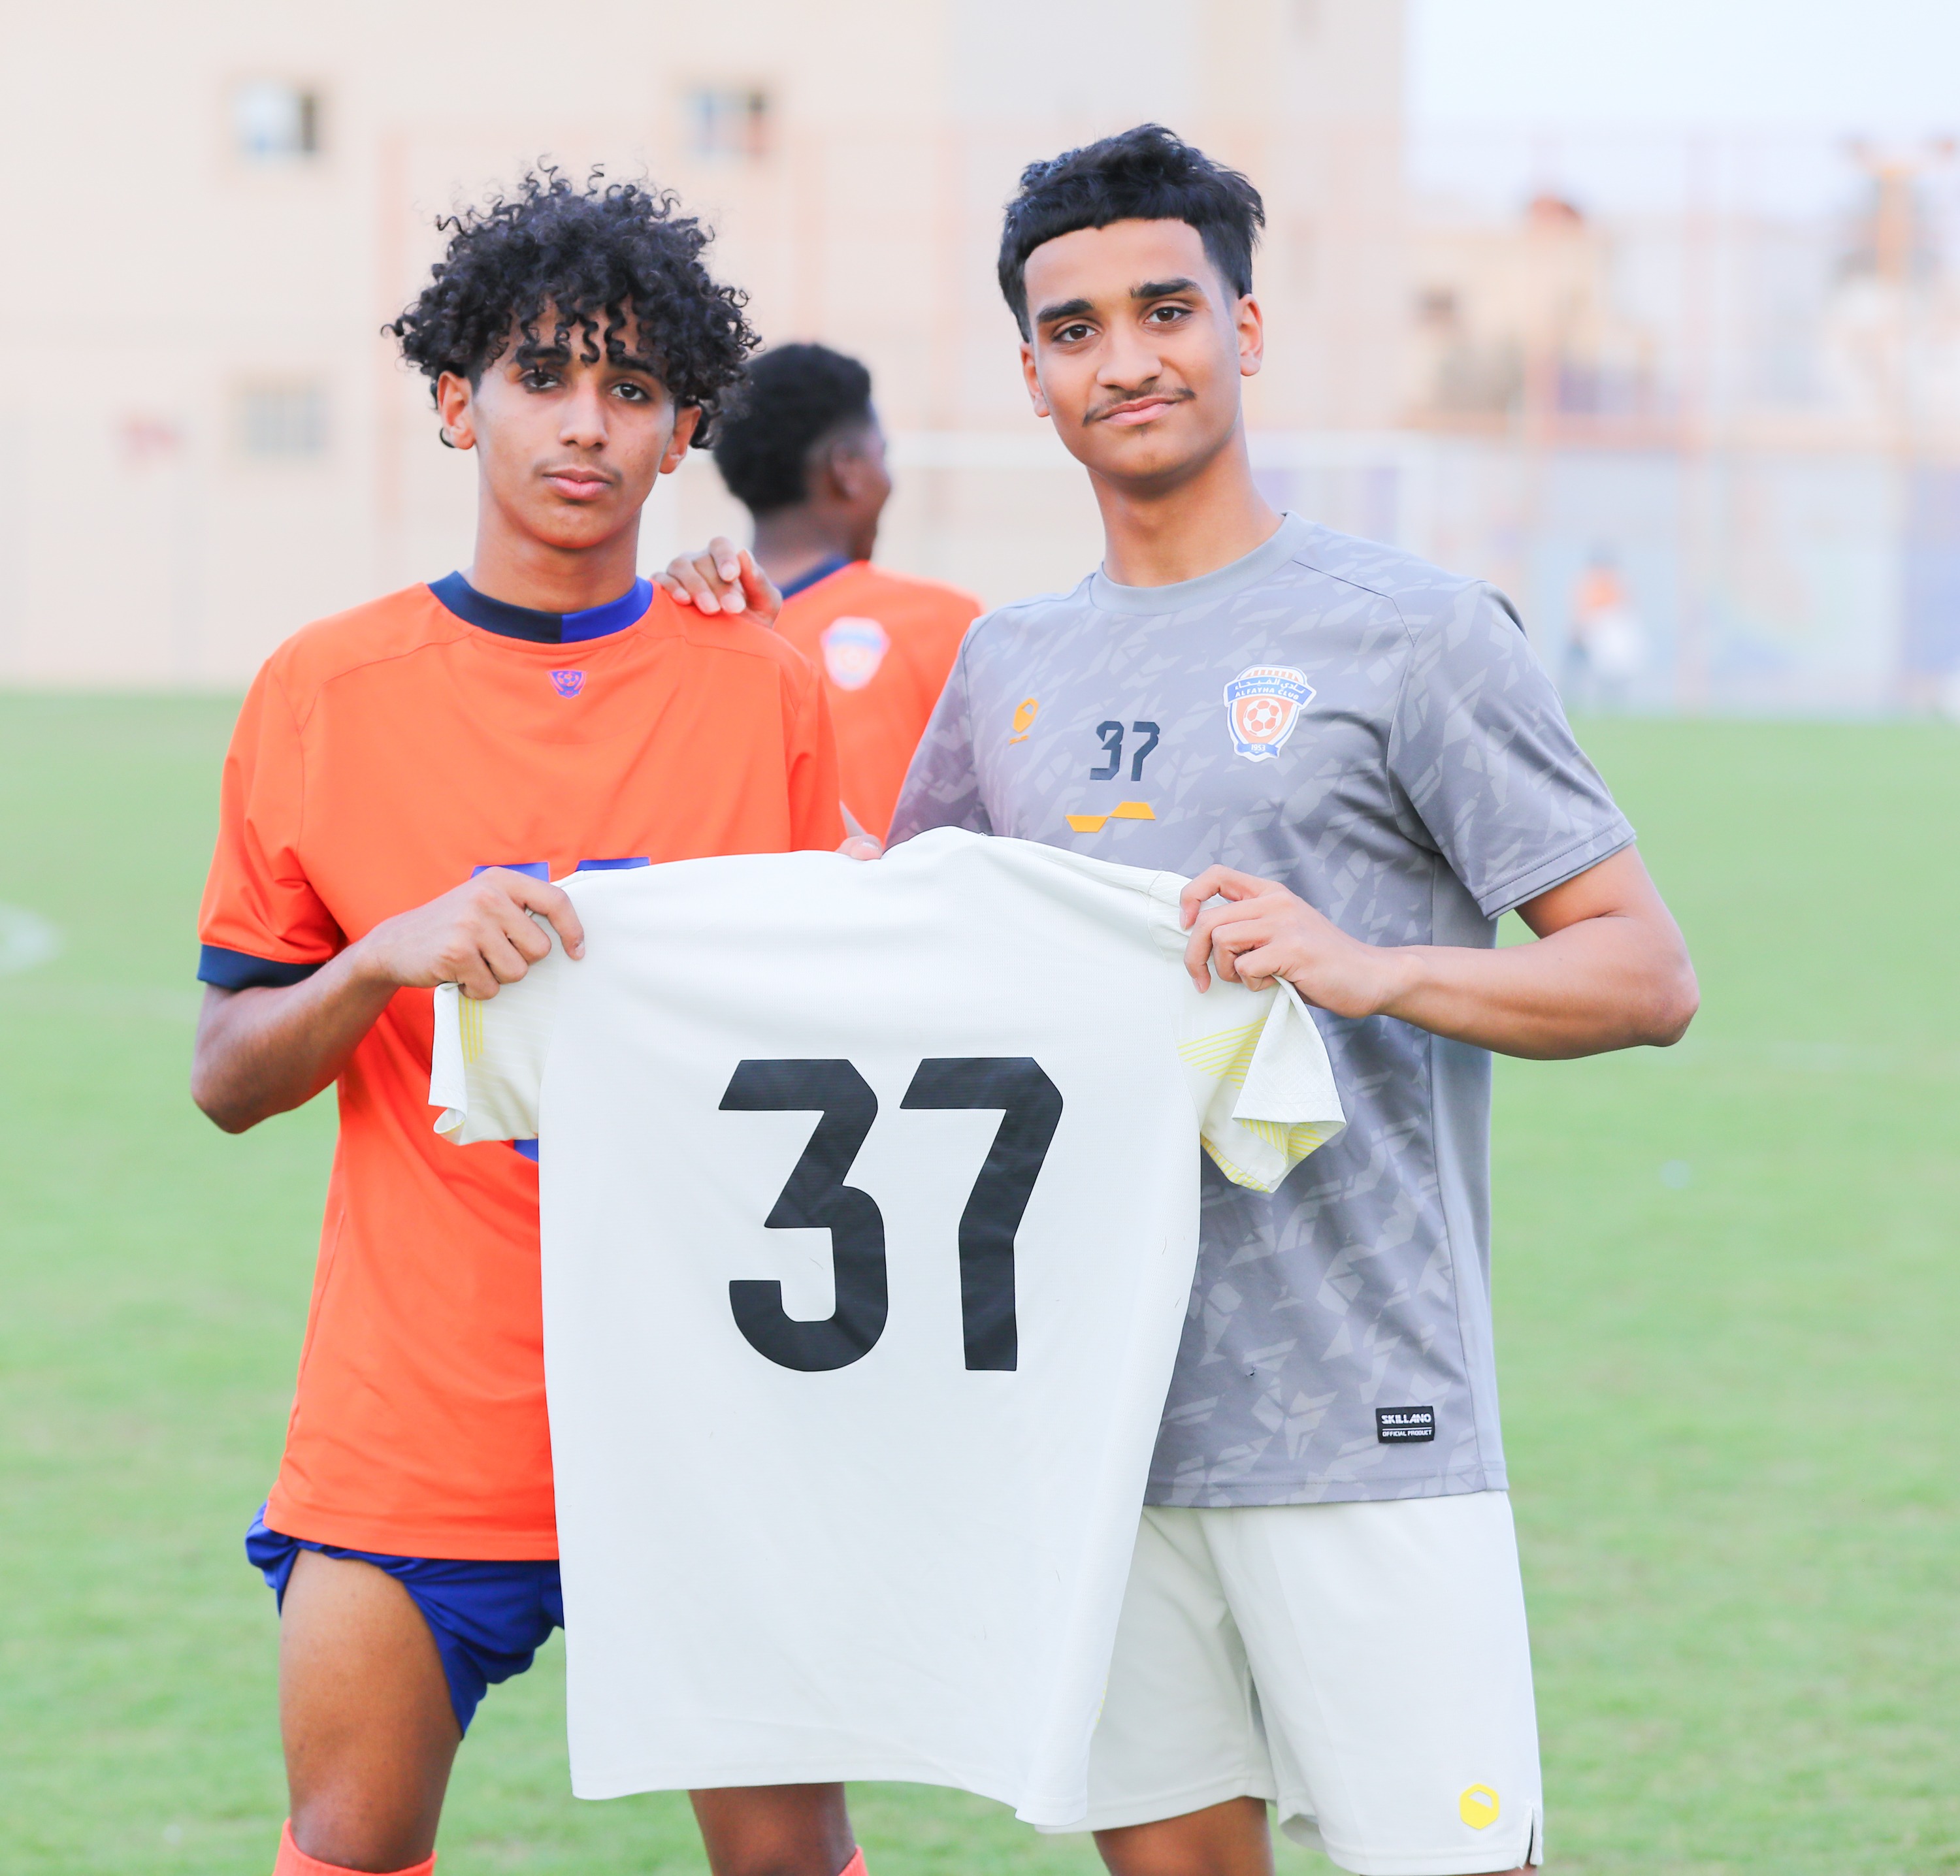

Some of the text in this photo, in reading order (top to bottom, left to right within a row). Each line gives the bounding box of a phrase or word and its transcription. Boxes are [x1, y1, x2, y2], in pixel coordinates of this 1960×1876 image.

[1234, 678, 1280, 690] الفيحاء
[1235, 687, 1299, 700] ALFAYHA CLUB
[1090, 720, 1160, 781] 37
[718, 1057, 1064, 1372] 37
[1380, 1414, 1431, 1424] SKILLANO
